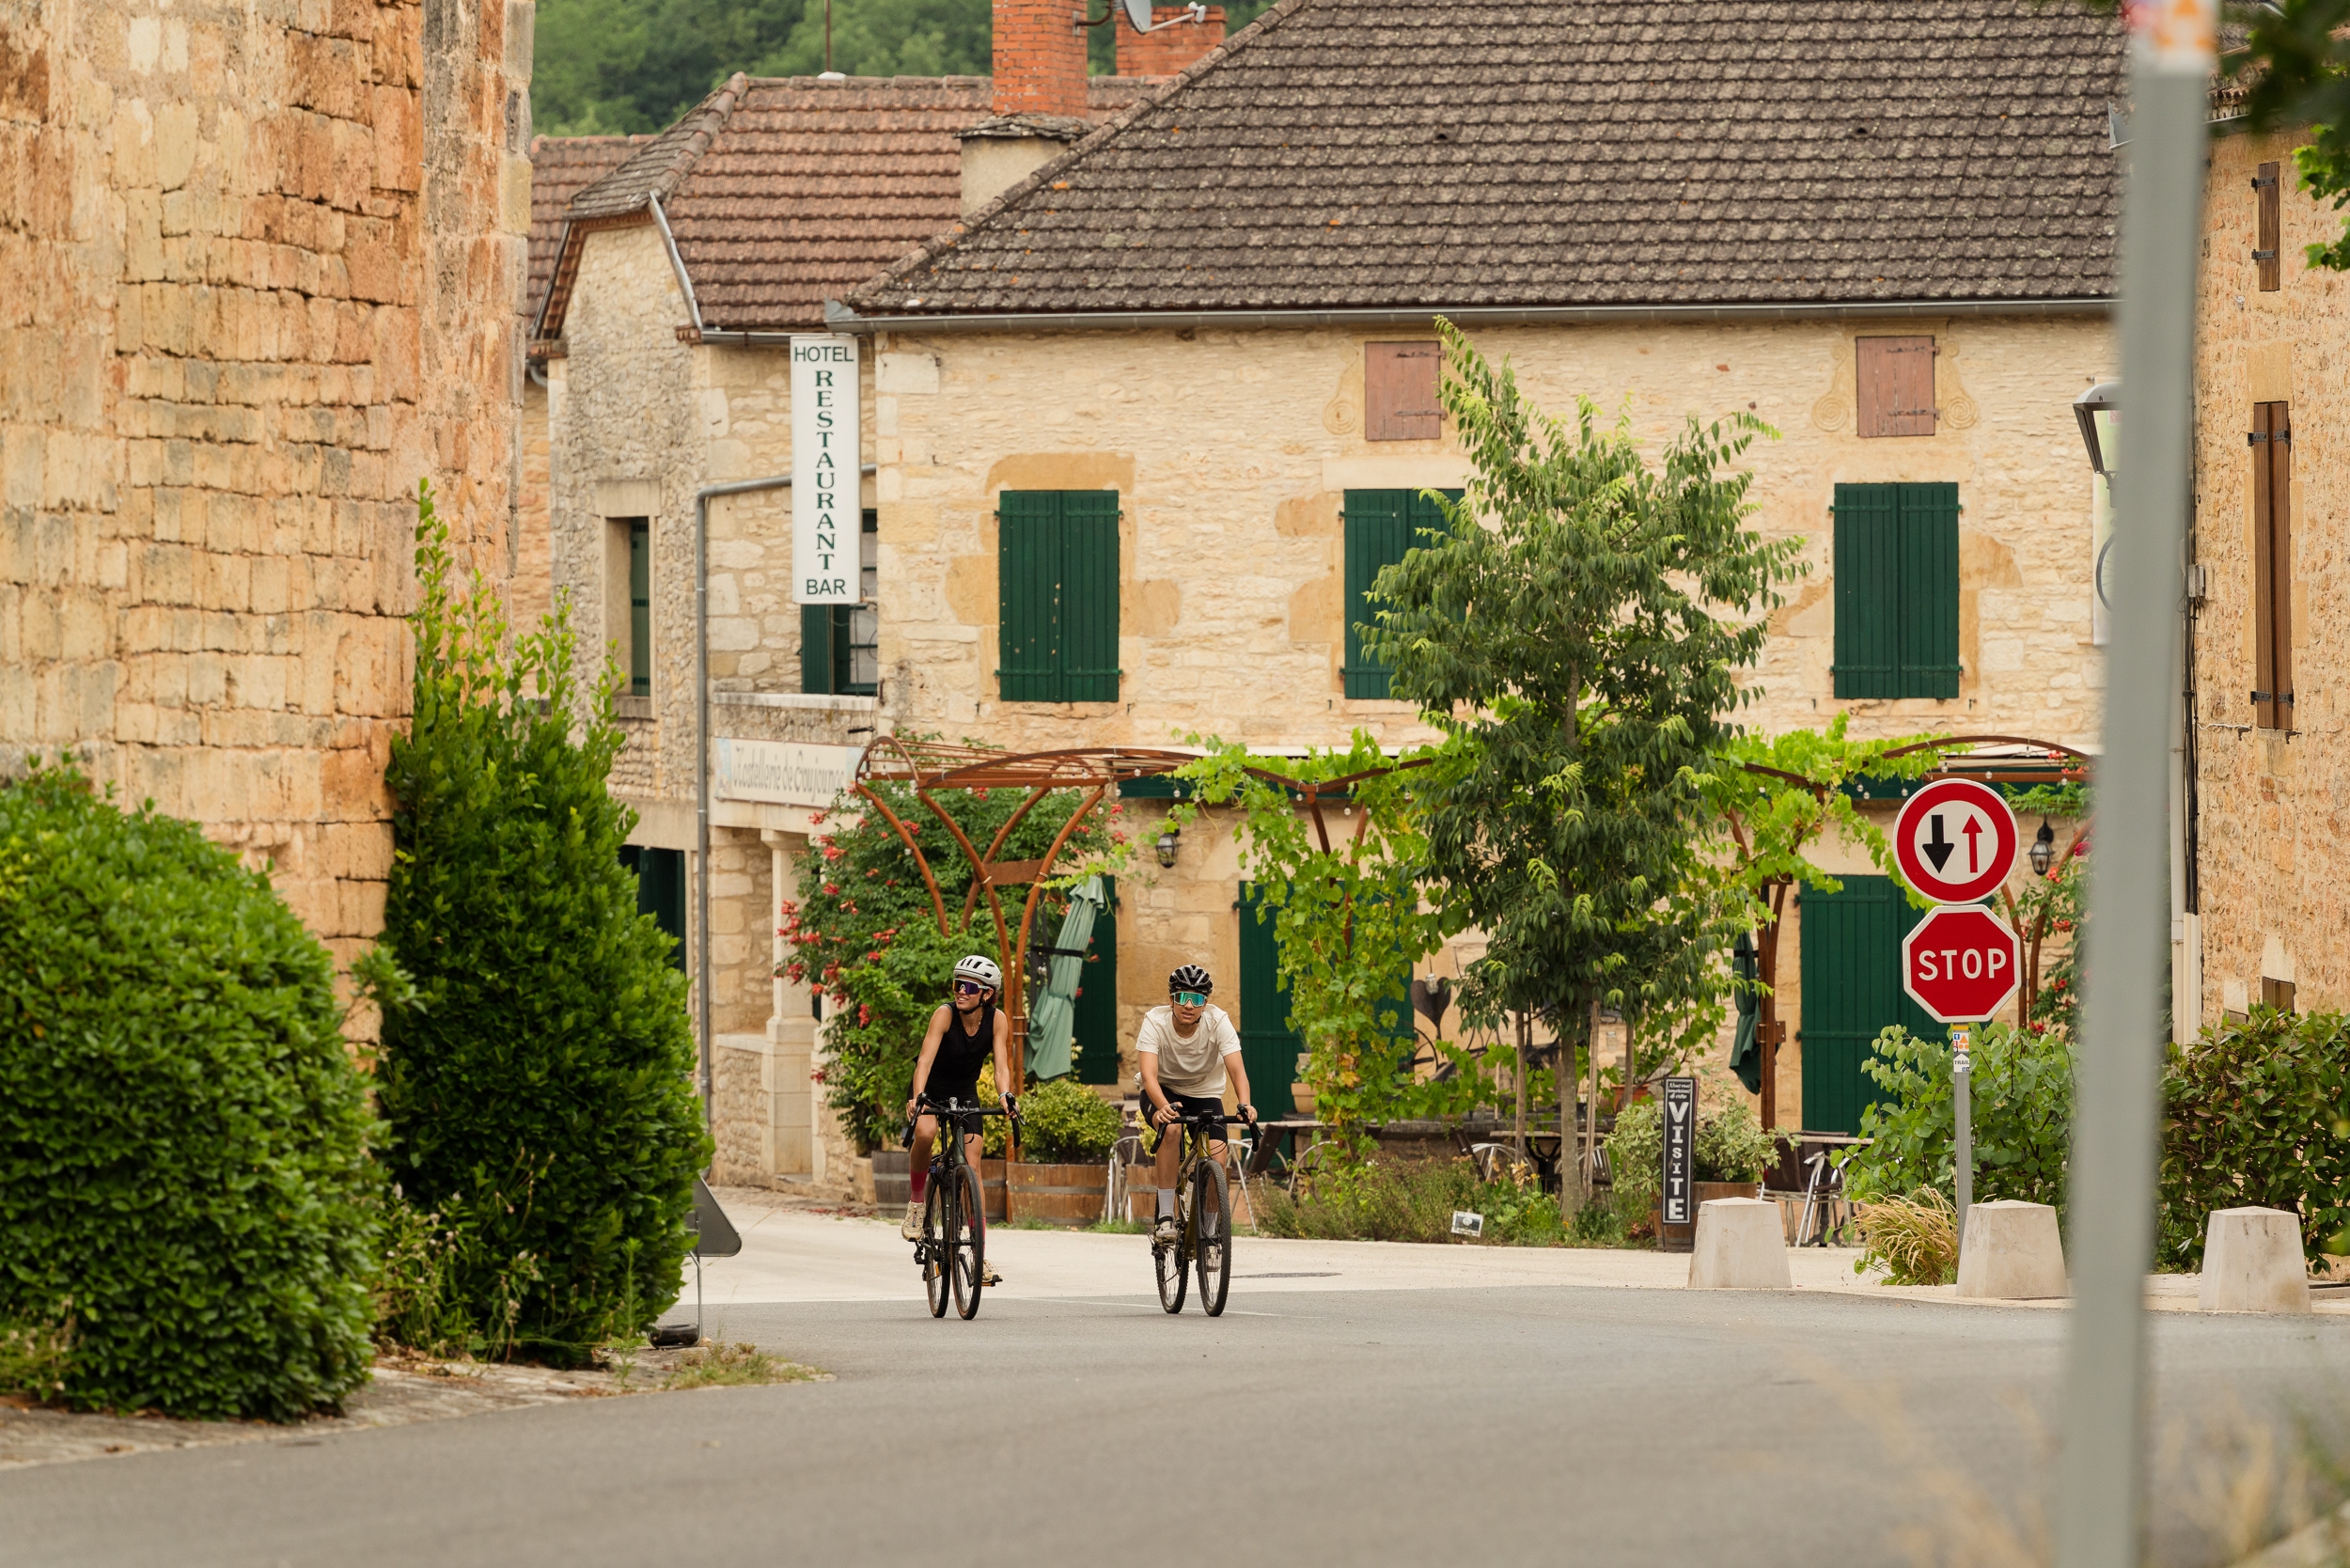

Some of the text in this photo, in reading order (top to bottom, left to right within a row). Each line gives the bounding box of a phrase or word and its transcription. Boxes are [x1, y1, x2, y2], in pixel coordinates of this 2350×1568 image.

[794, 346, 854, 363] HOTEL
[815, 369, 836, 571] RESTAURANT
[806, 579, 846, 595] BAR
[1918, 948, 2007, 981] STOP
[1668, 1101, 1689, 1220] VISITE
